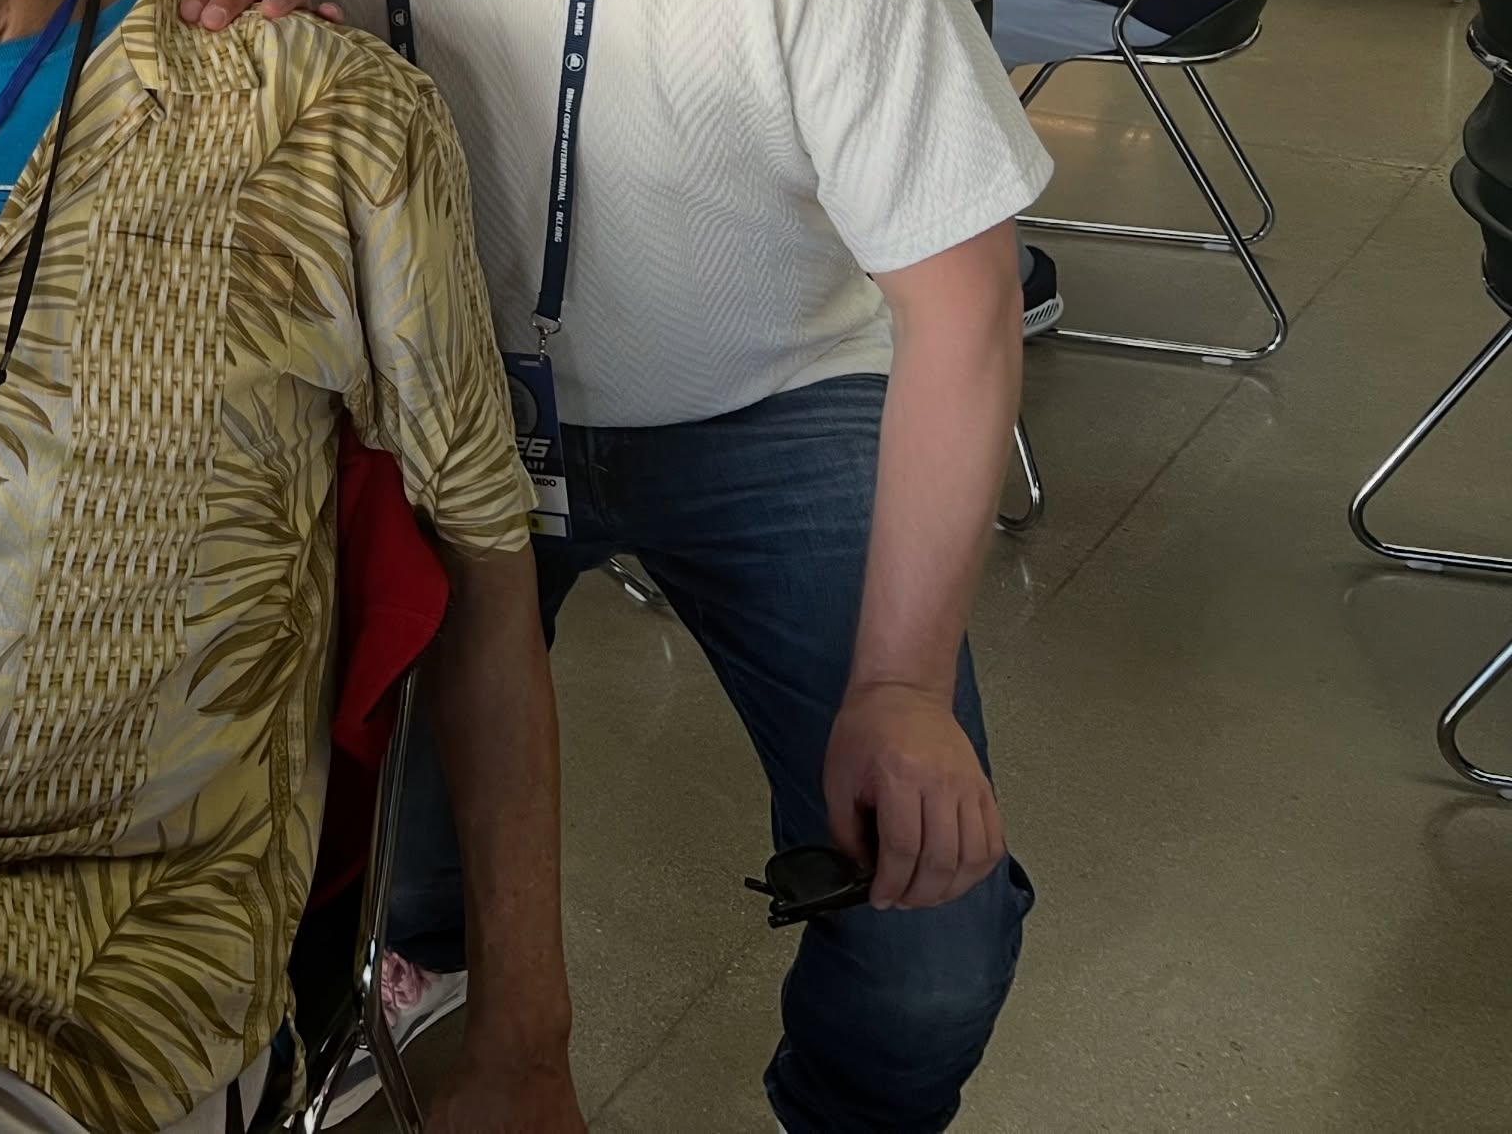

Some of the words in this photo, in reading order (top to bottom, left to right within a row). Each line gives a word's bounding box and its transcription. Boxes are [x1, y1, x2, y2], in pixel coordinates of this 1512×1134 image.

[565, 87, 575, 113] DRUM
[562, 113, 571, 139] CORPS
[557, 140, 569, 201] INTERNATIONAL
[517, 436, 551, 458] 26
